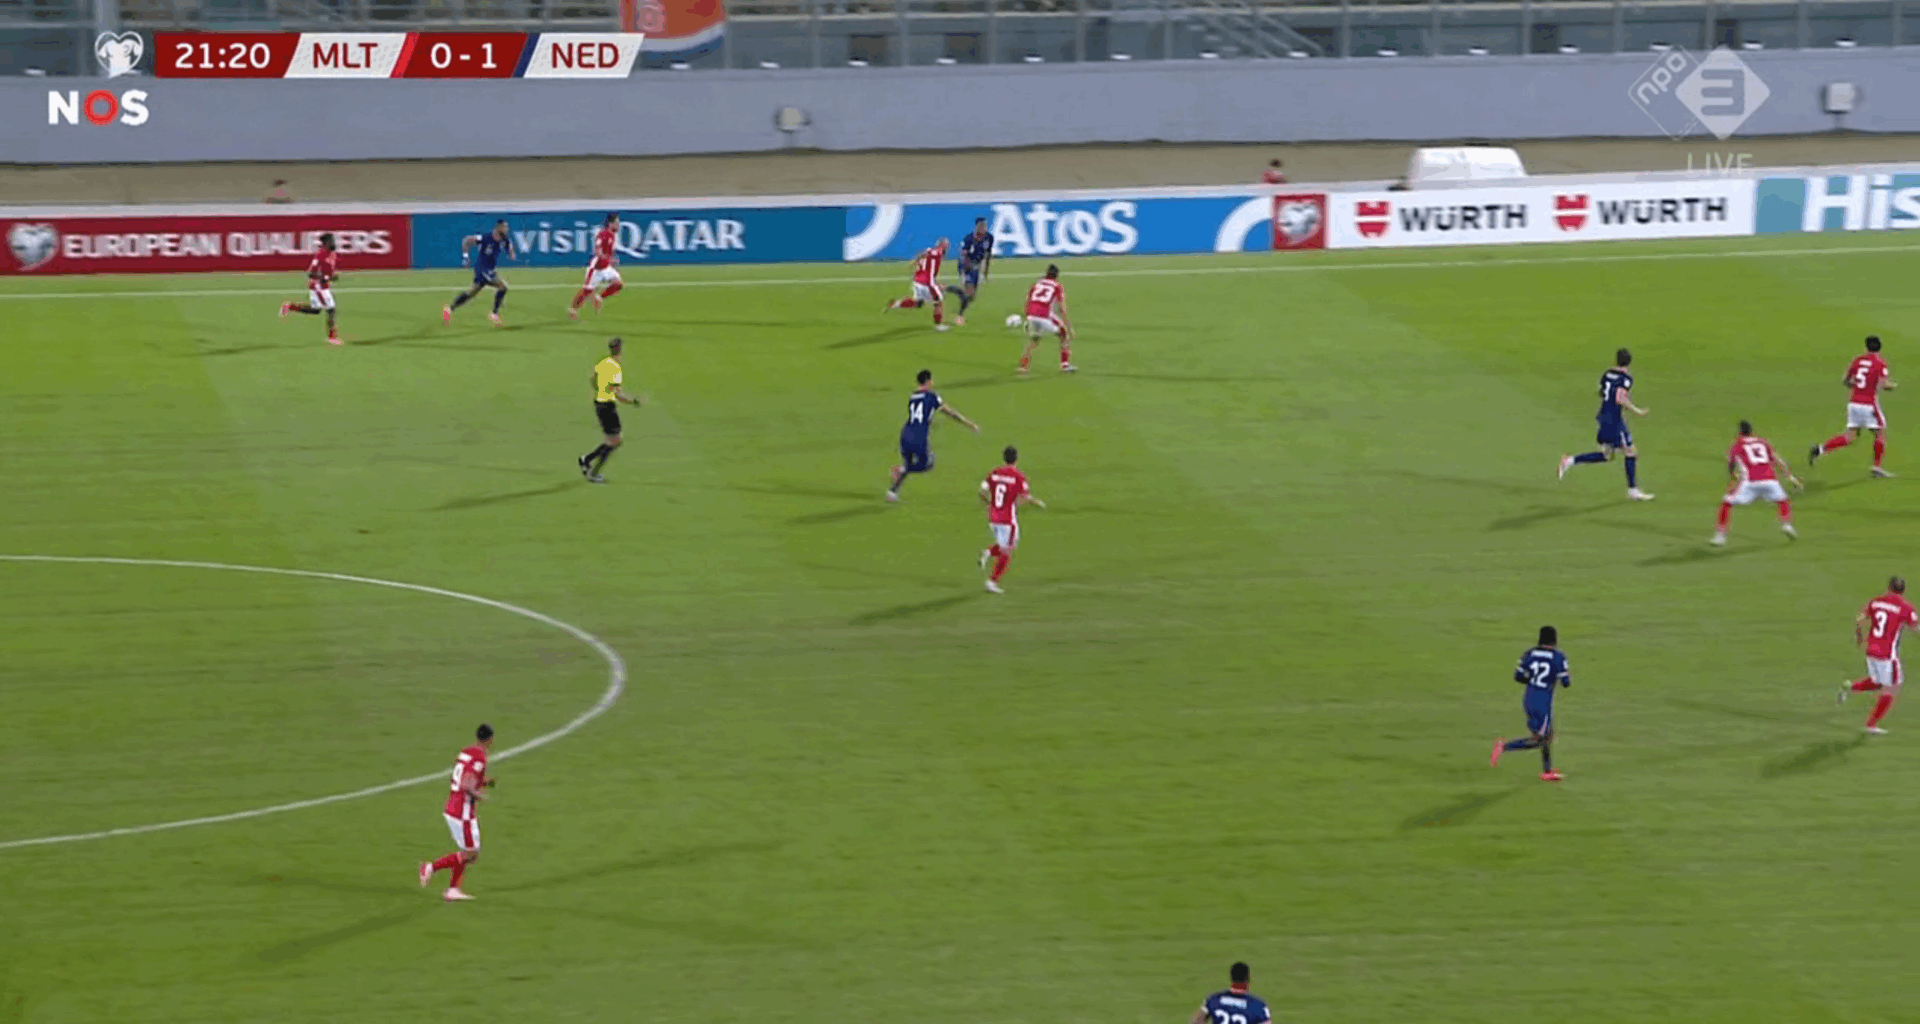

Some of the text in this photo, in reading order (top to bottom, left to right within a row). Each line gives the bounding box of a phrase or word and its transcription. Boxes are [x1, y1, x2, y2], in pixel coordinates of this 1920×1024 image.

[1801, 172, 1920, 232] His
[62, 230, 393, 258] EUROPEAN QUALIFERS
[613, 218, 746, 259] QATAR
[1031, 284, 1055, 303] 23
[1856, 367, 1869, 389] 5
[909, 401, 925, 424] 14
[994, 483, 1008, 508] 6
[1873, 610, 1888, 638] 3
[1528, 660, 1550, 689] 12
